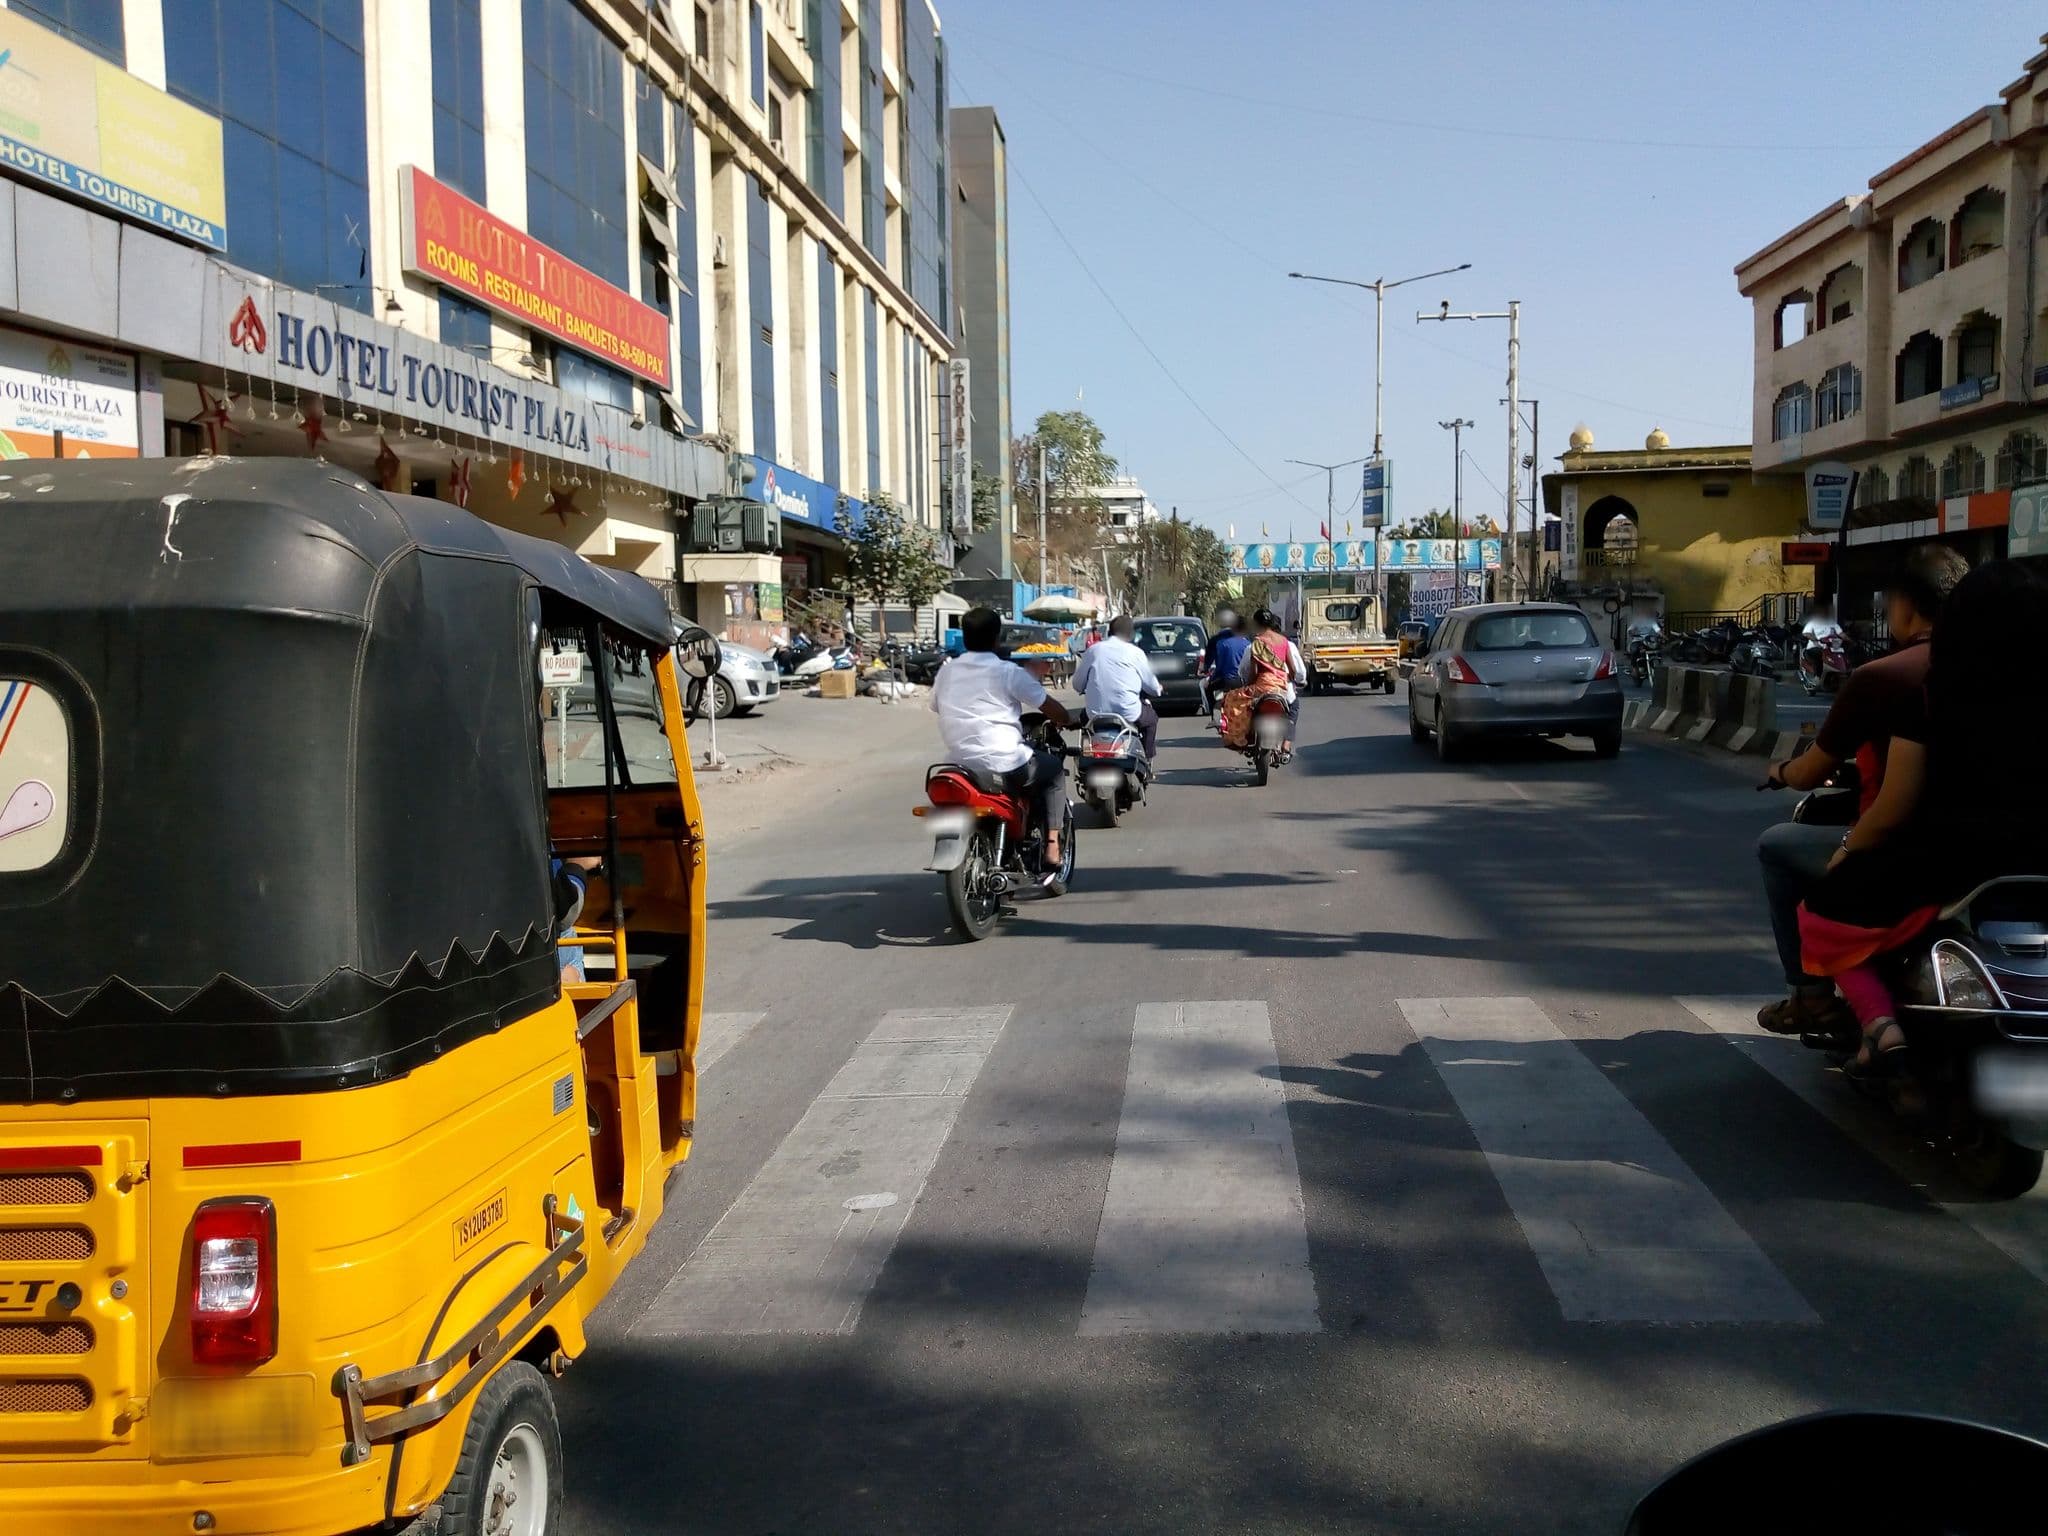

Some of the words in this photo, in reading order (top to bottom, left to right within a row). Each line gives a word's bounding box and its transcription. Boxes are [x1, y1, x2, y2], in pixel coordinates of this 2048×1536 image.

[0, 138, 71, 184] HOTEL
[76, 170, 157, 218] TOURIST
[162, 206, 214, 242] PLAZA
[426, 240, 483, 293] ROOMS,
[485, 269, 564, 334] RESTAURANT,
[565, 312, 618, 355] BANQUETS
[619, 340, 646, 368] 50-500
[647, 355, 664, 378] PAX
[457, 206, 533, 286] HOTEL
[536, 252, 612, 323] TOURIST
[616, 306, 664, 350] PLAZA
[41, 374, 80, 391] HOTEL
[73, 393, 122, 417] PLAZA
[277, 312, 398, 396] HOTEL
[403, 354, 518, 431] TOURIST
[524, 396, 591, 452] PLAZA
[953, 374, 965, 449] TOURIST
[545, 657, 553, 670] NO
[555, 656, 578, 669] PARKING
